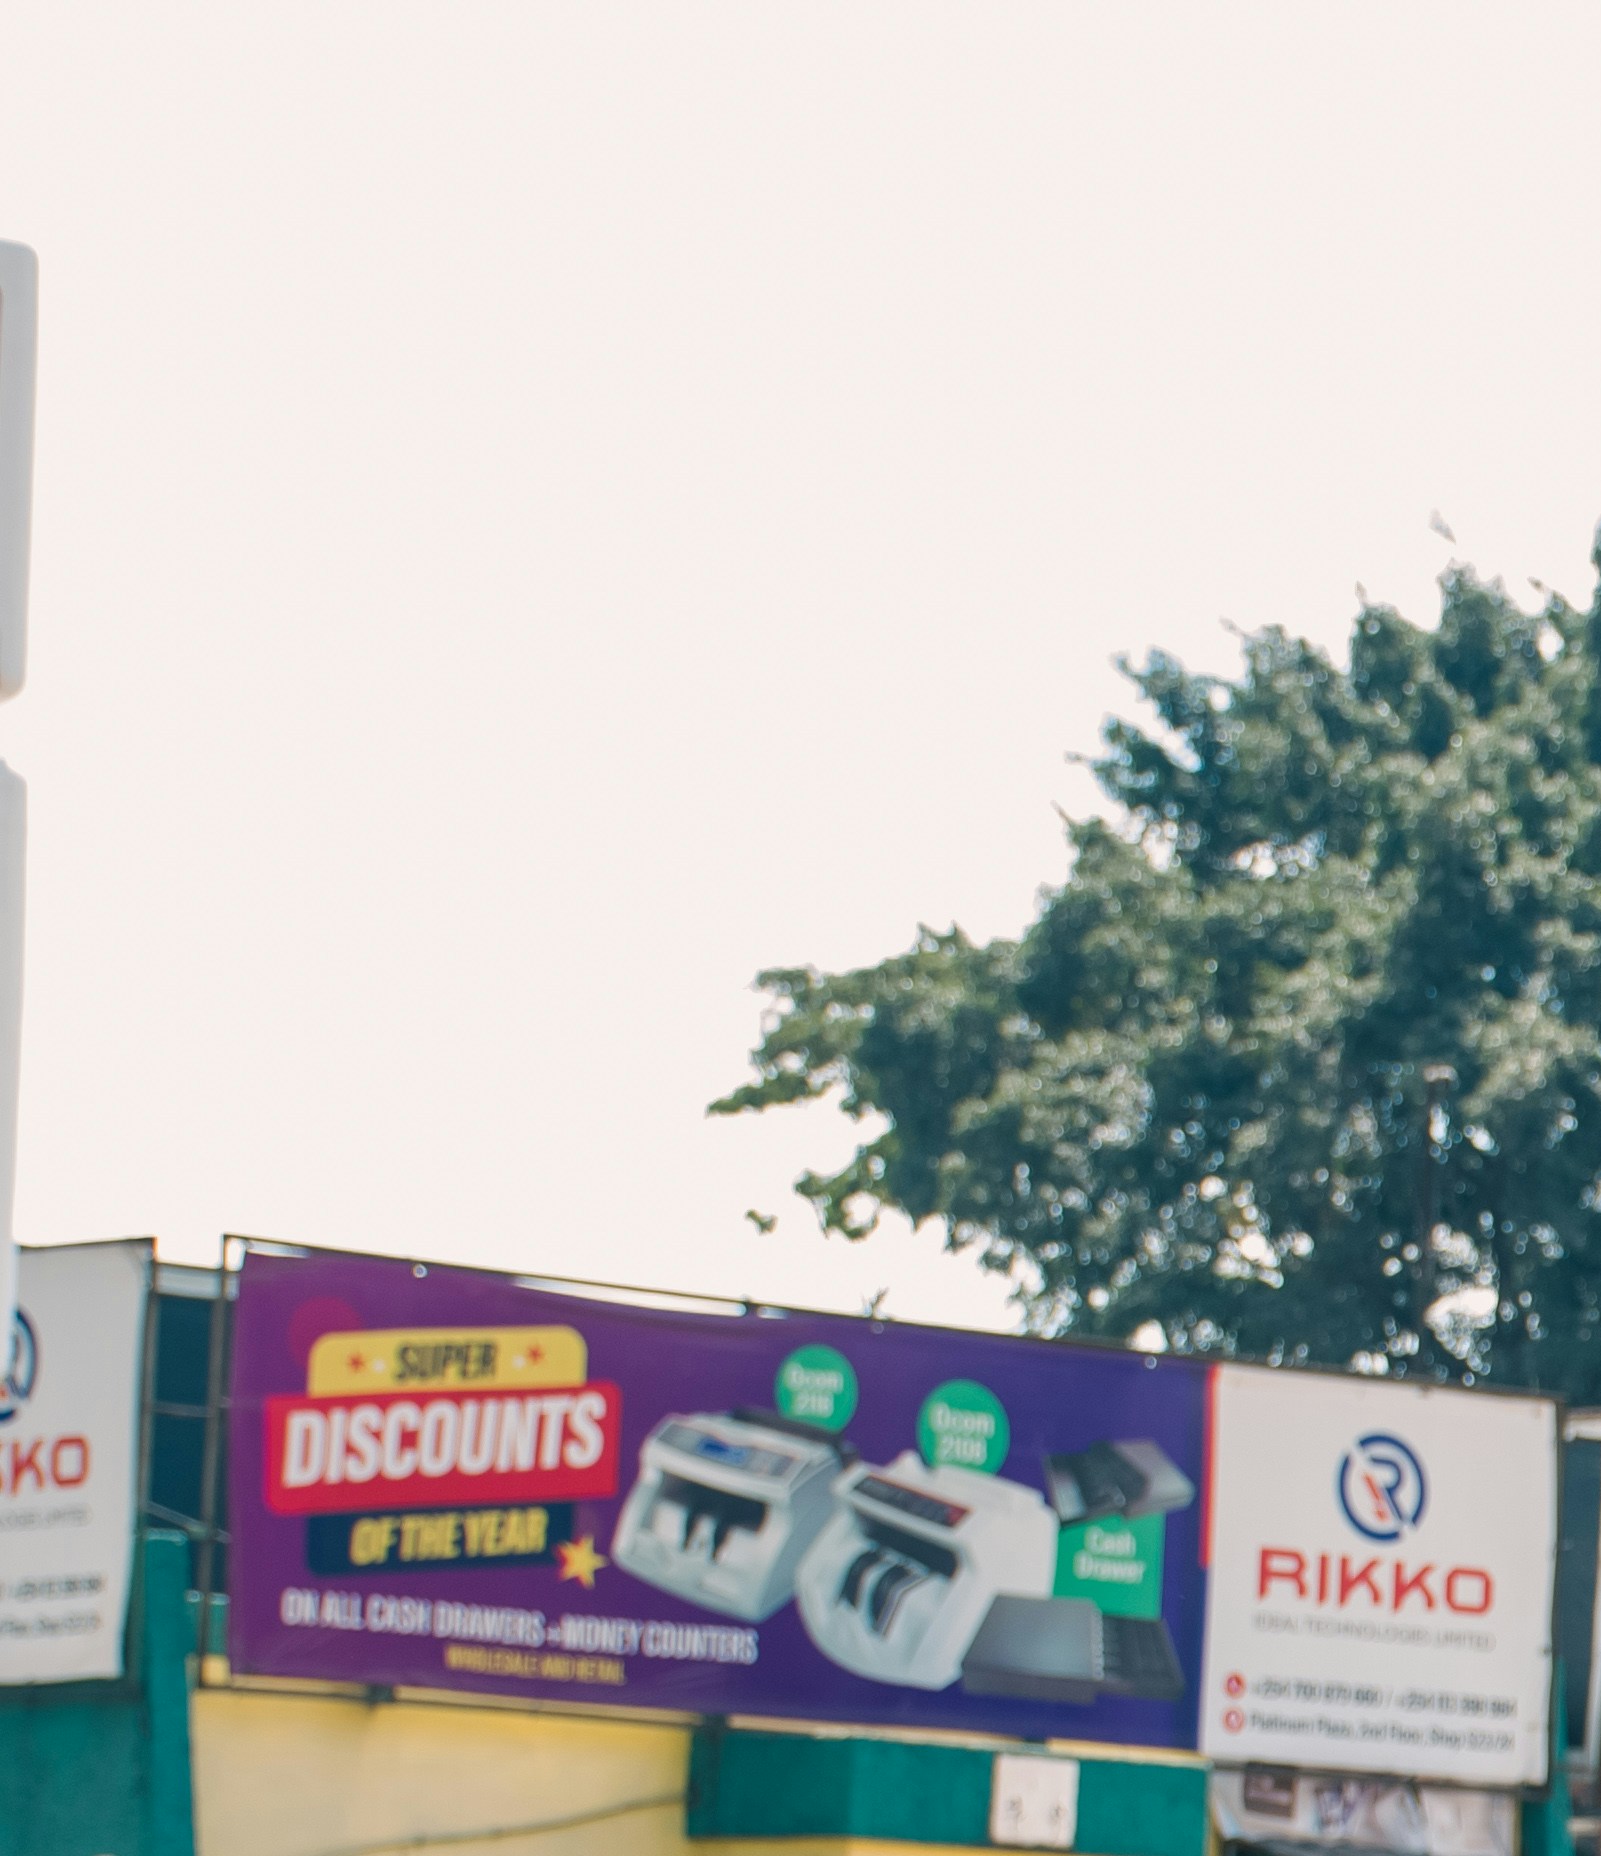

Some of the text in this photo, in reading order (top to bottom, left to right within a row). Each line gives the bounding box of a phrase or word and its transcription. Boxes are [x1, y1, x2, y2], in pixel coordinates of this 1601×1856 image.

[394, 1341, 496, 1380] SUPER
[282, 1391, 607, 1489] DISCOUNTS
[350, 1506, 549, 1566] OF THE YEAR
[1084, 1526, 1136, 1557] Cash
[1074, 1553, 1148, 1584] Drawer
[1255, 1546, 1496, 1615] RIKKO
[281, 1587, 320, 1627] ON
[321, 1590, 363, 1632] ALL
[365, 1593, 431, 1636] CASH
[433, 1599, 545, 1648] DRAWERS
[643, 1620, 759, 1665] COUNTERS
